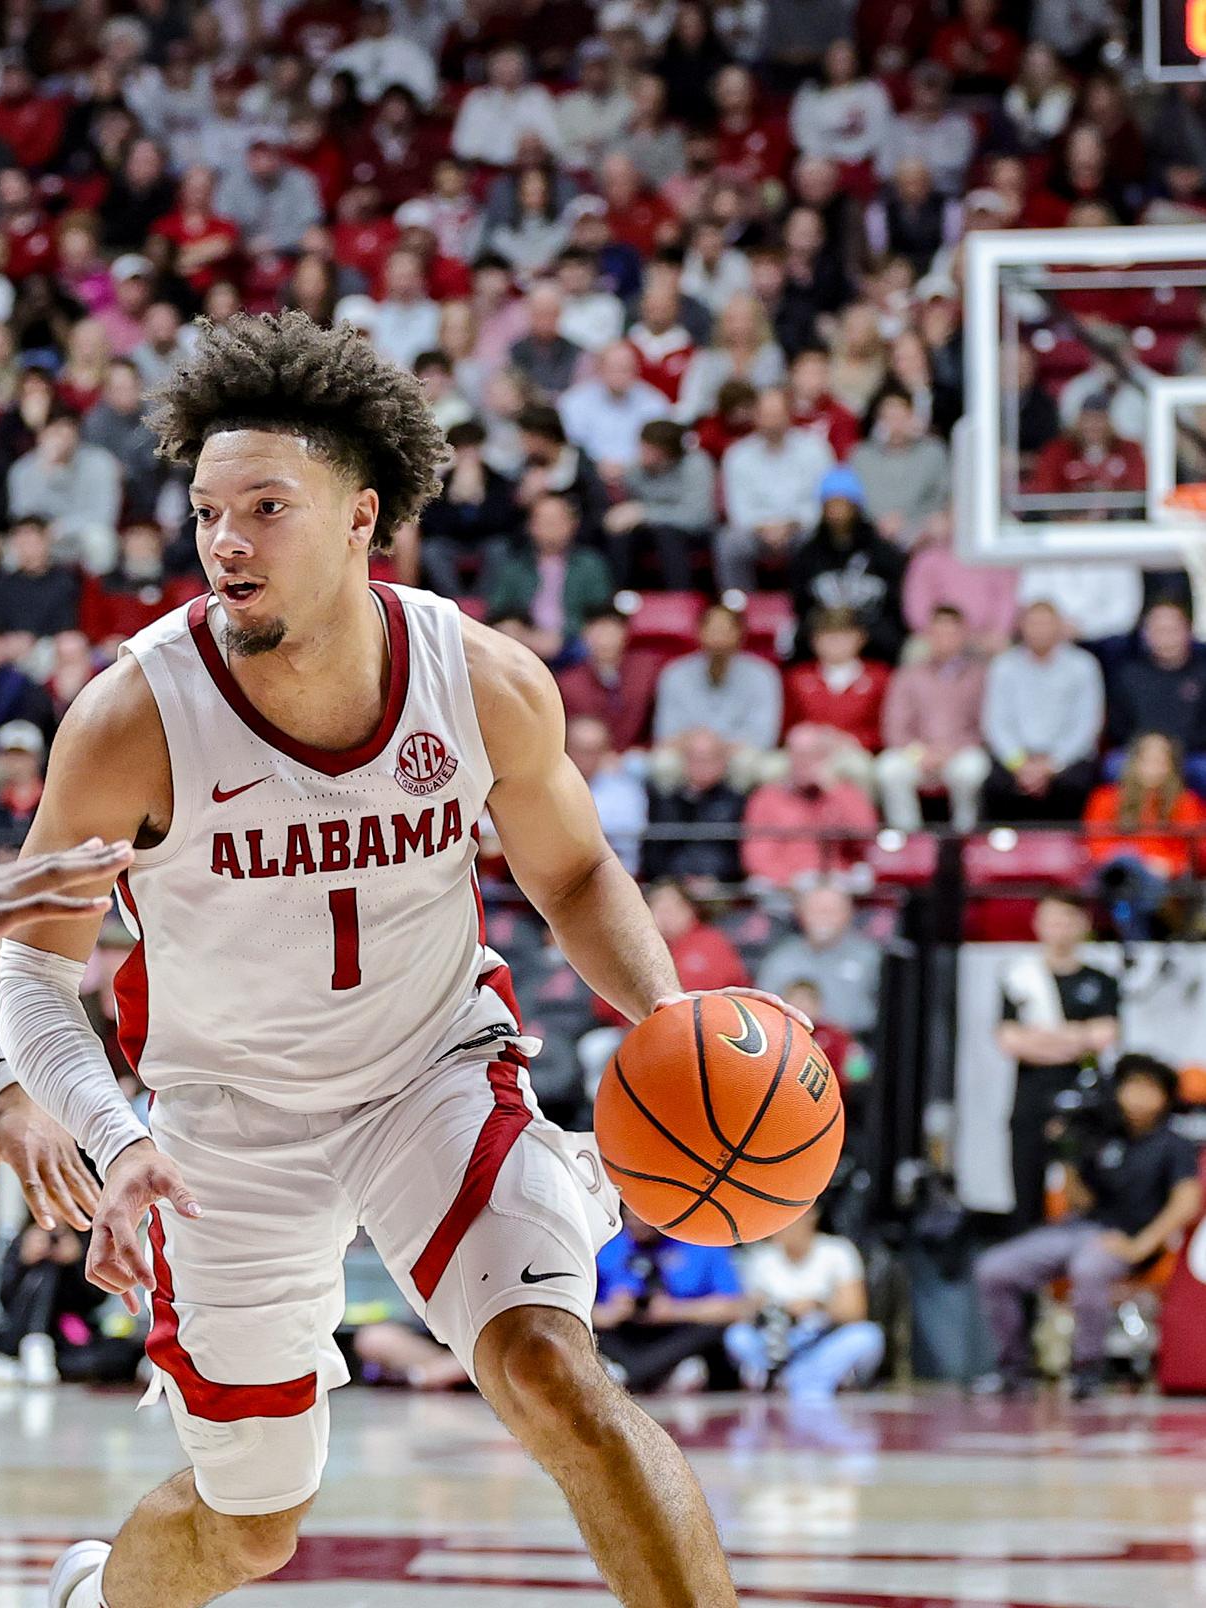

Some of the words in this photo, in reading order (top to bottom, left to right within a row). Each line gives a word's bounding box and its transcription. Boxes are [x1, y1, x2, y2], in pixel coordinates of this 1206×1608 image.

[401, 735, 443, 779] SEC
[402, 769, 451, 794] GRADUATE
[210, 798, 462, 879] ALABAMA
[328, 887, 361, 990] 1
